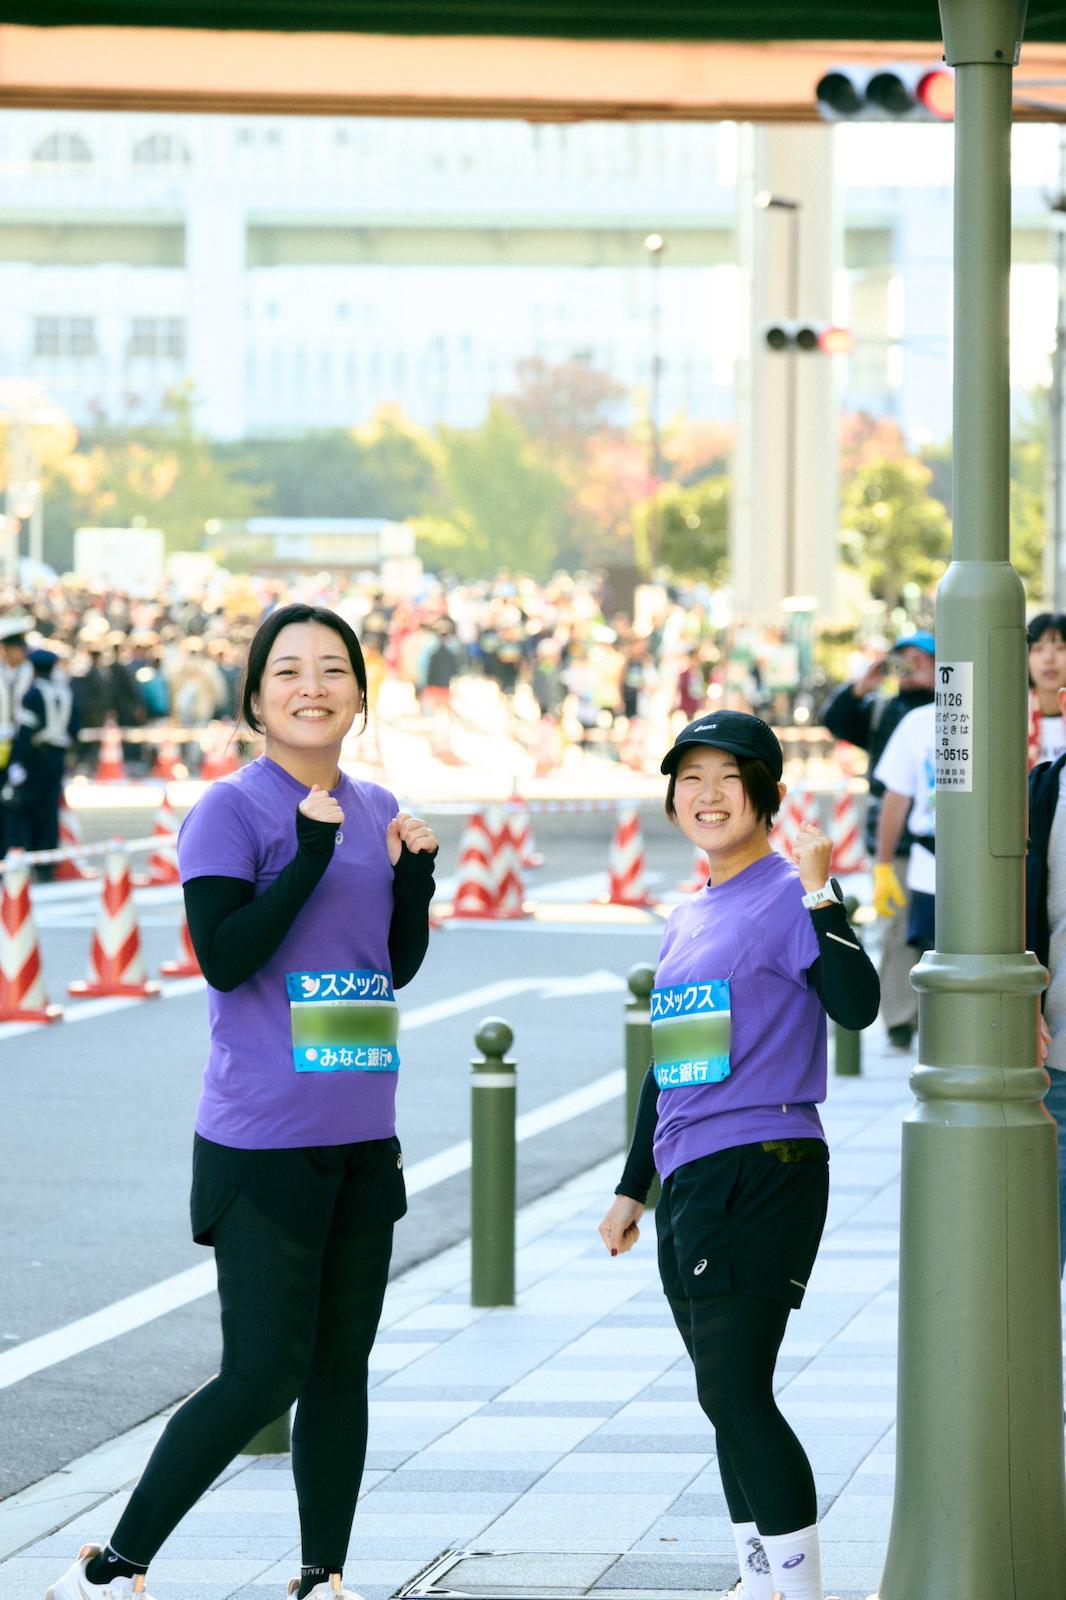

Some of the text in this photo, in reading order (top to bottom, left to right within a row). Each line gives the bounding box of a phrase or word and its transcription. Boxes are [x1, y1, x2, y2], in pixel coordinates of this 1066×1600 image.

[301, 973, 389, 998] シスメックス
[319, 1047, 390, 1068] みなと銀行
